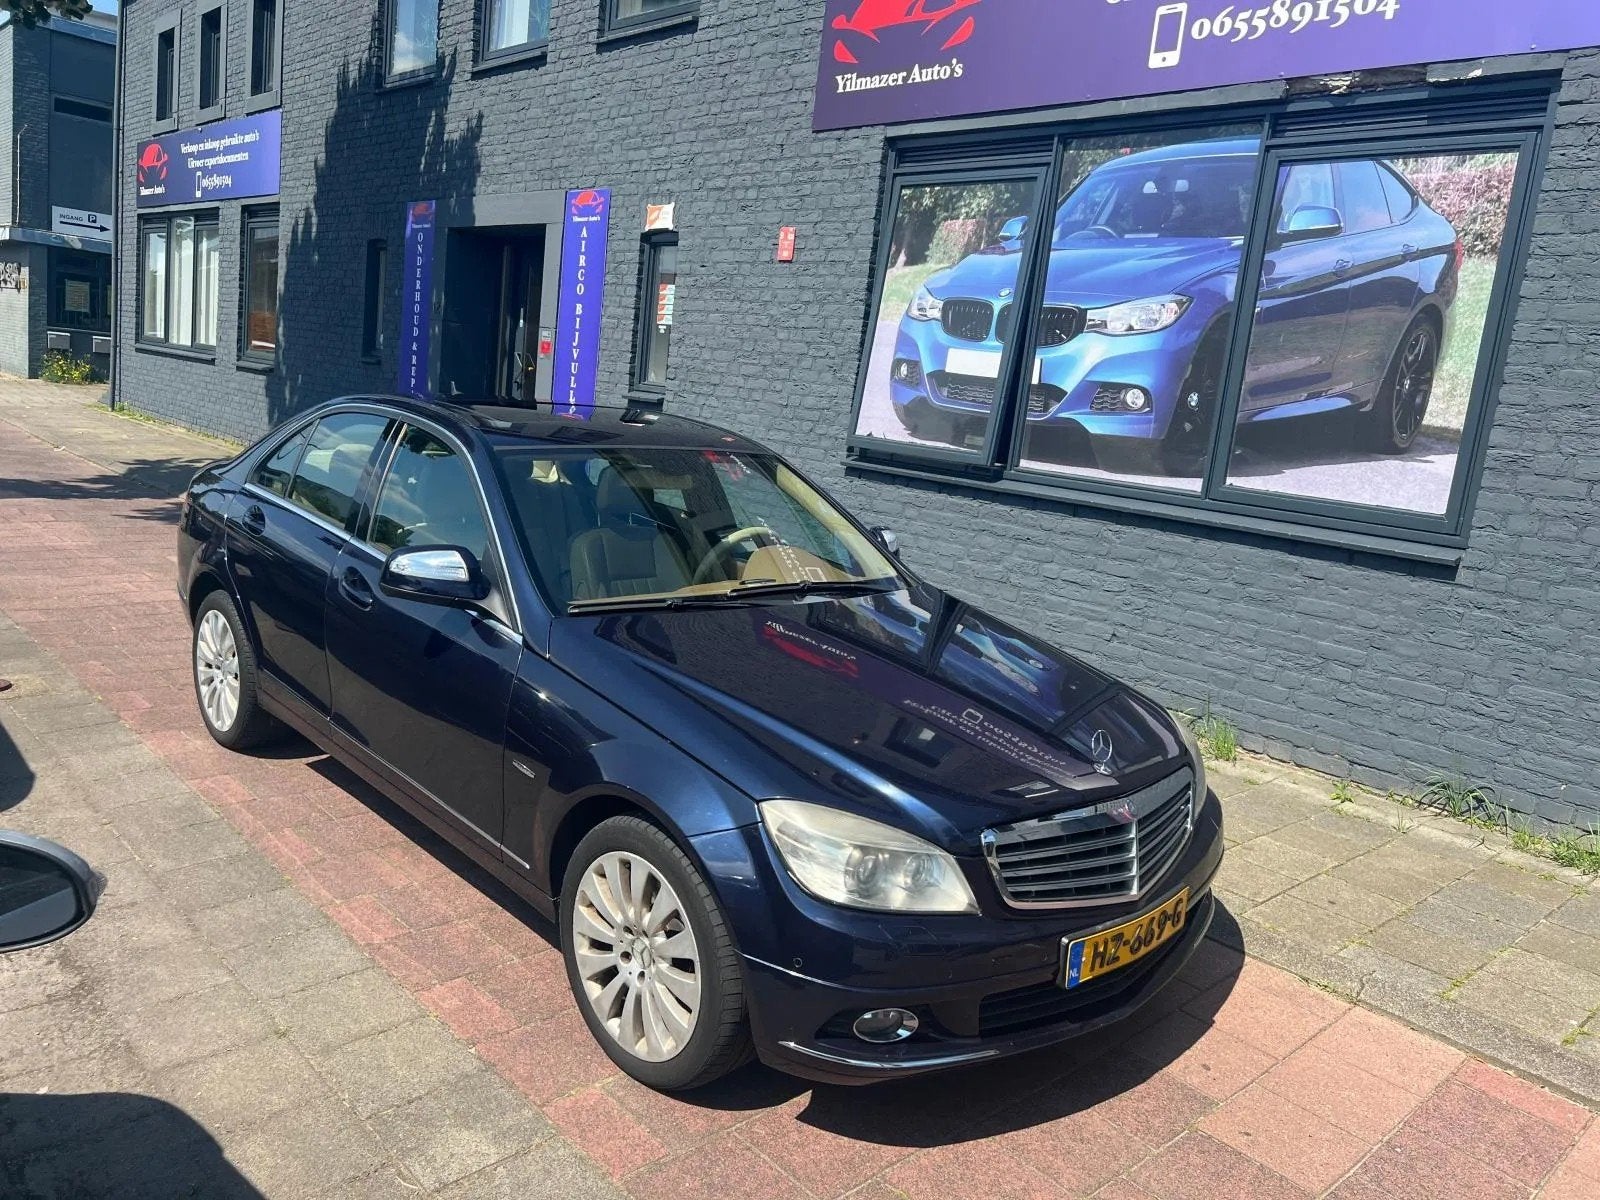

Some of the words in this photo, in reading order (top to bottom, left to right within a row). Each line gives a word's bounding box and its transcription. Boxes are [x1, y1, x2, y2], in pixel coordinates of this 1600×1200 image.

[1191, 0, 1400, 43] 0655891504
[835, 72, 906, 93] Yilmazer
[907, 58, 963, 84] Auto's
[59, 213, 84, 222] INGANG
[576, 226, 588, 295] AIRCO
[413, 231, 424, 337] ONDERHOUD
[1089, 897, 1184, 973] HZ-669-G
[1069, 968, 1079, 979] NL
